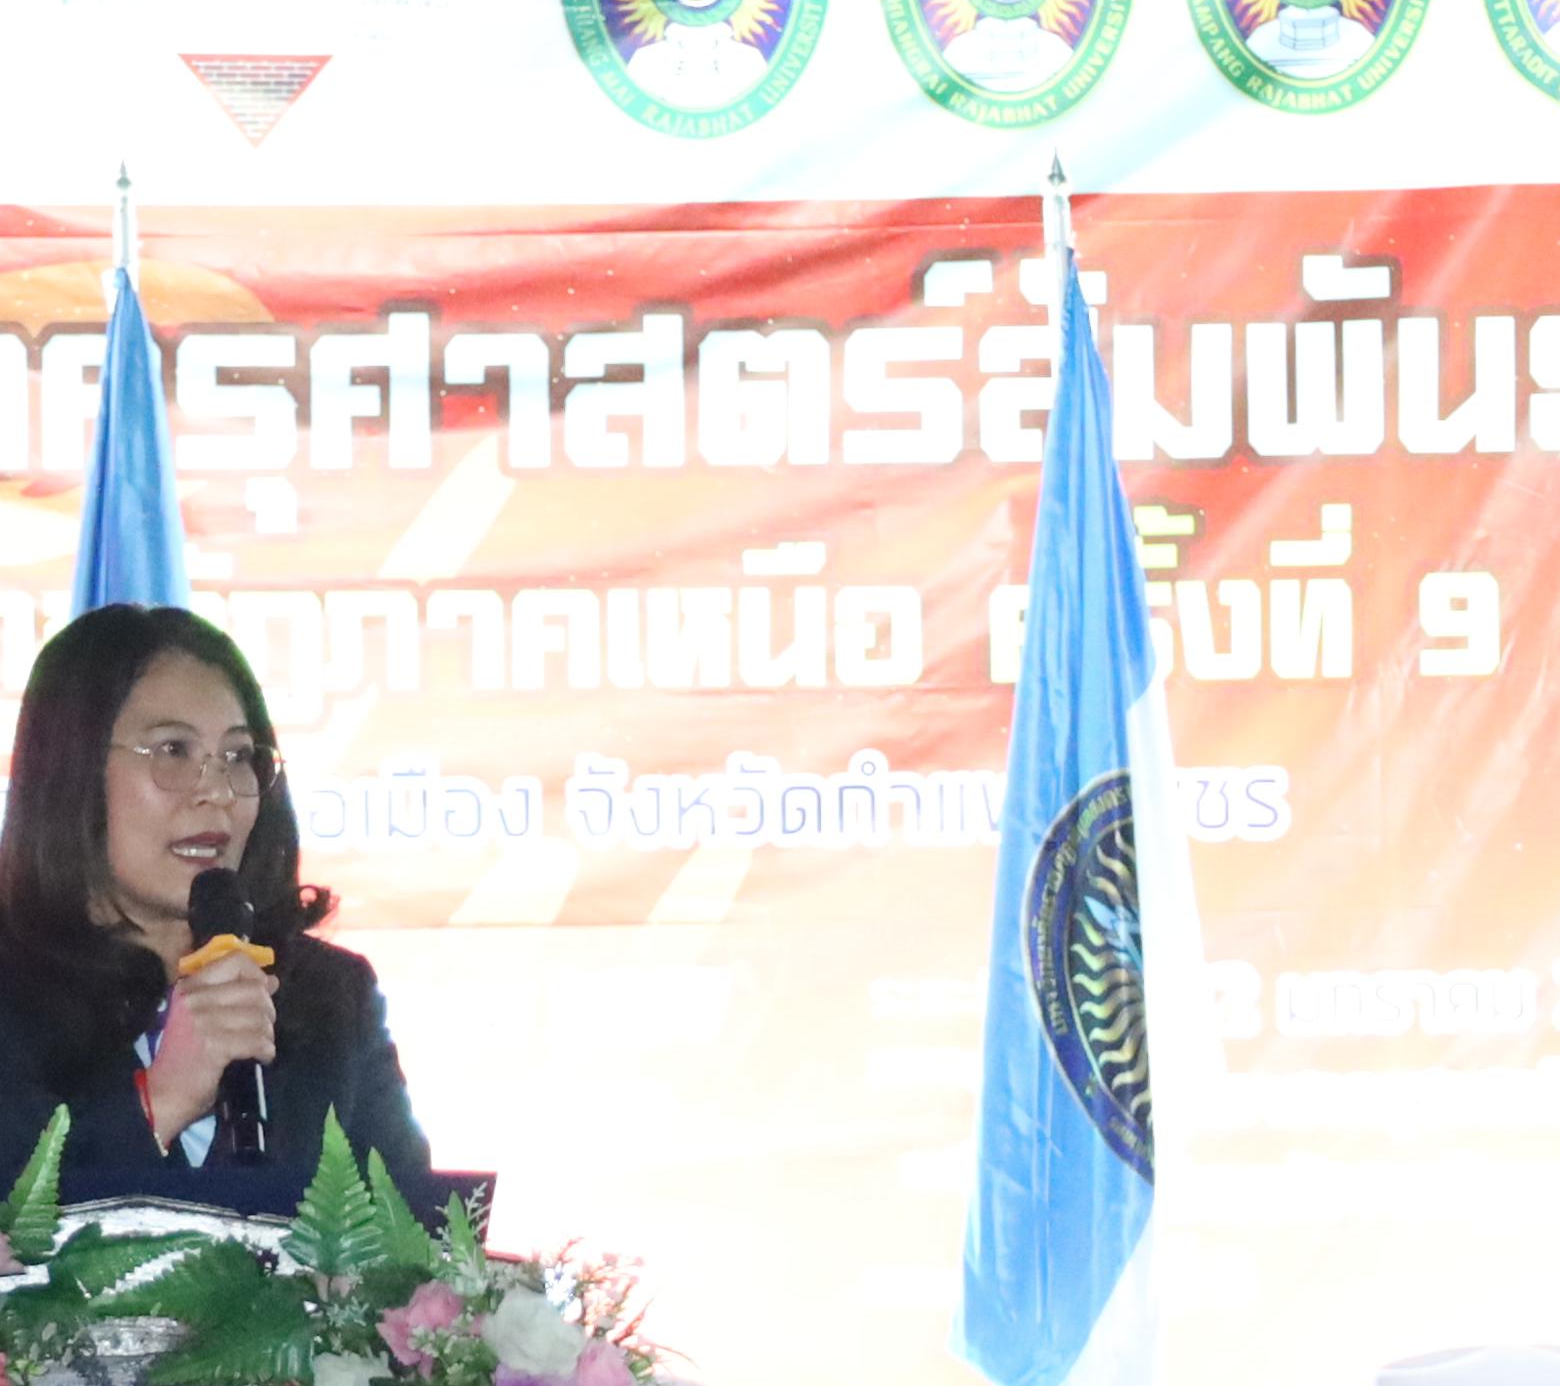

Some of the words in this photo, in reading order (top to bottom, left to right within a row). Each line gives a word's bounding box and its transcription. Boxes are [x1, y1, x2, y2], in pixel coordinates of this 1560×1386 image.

[949, 90, 1059, 125] RAJABHAT
[1247, 76, 1355, 108] RAJABHAT
[1417, 570, 1502, 677] 9
